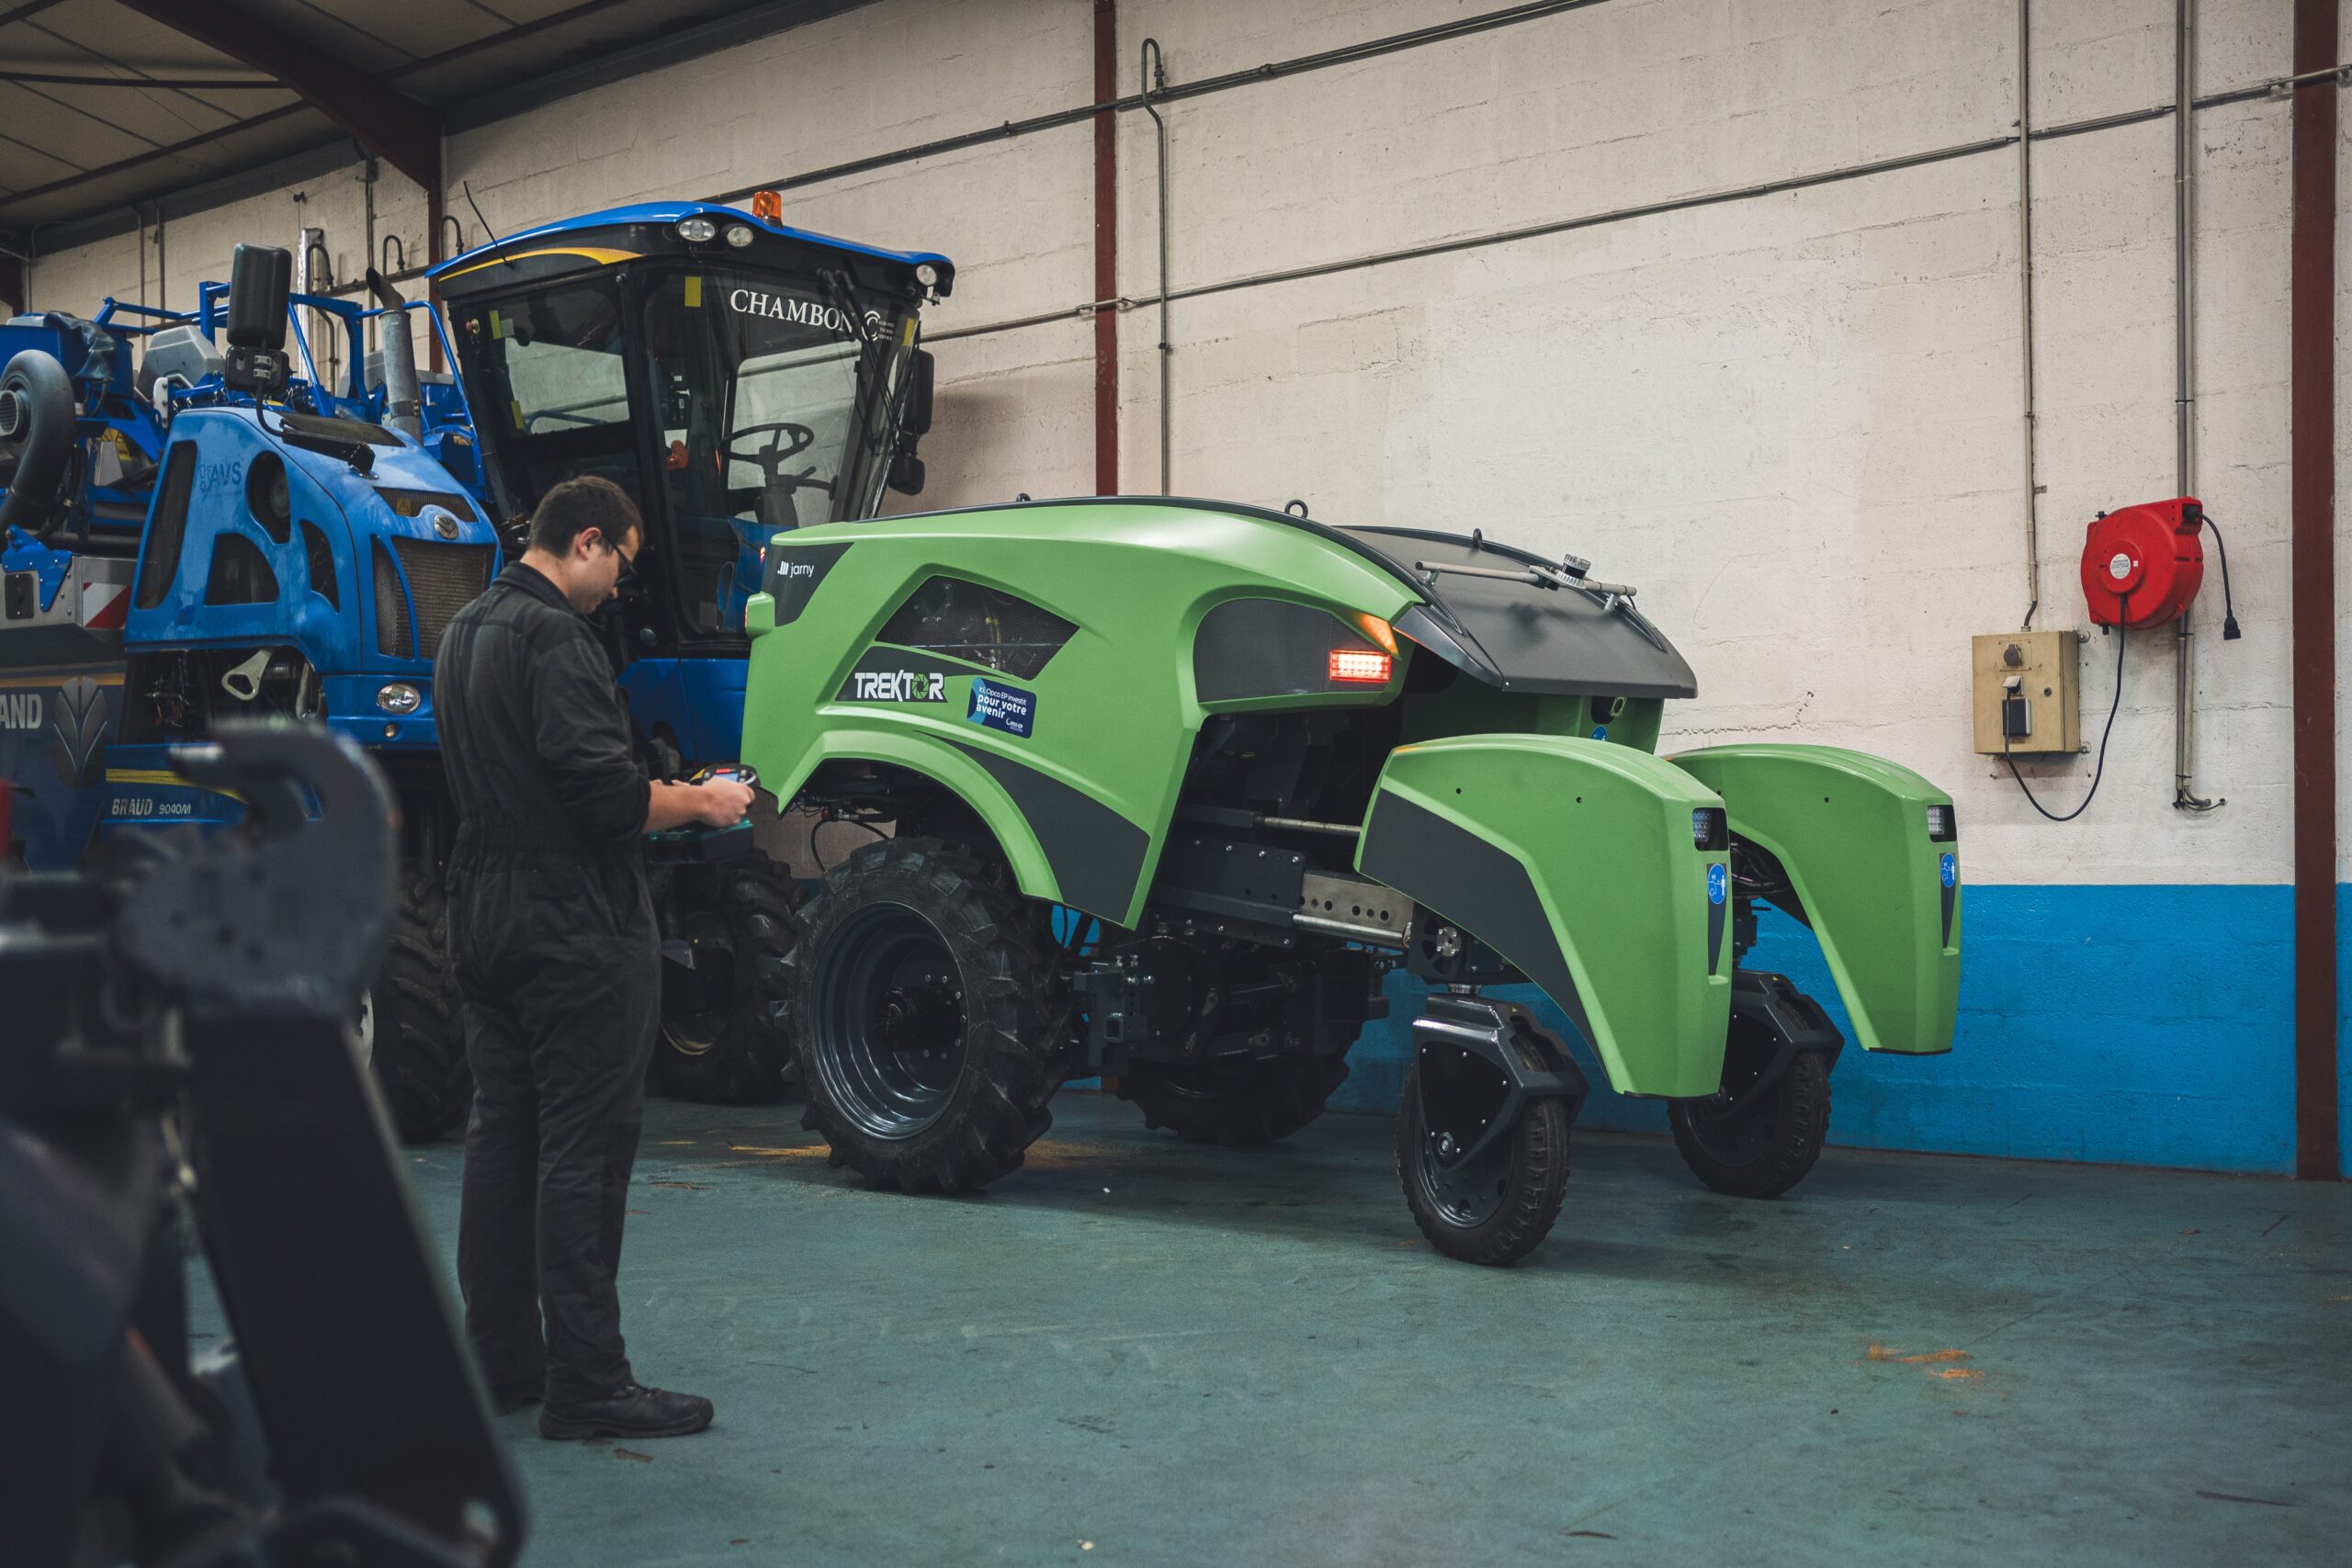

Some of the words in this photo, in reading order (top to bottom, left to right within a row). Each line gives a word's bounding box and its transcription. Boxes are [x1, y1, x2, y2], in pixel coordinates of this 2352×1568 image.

[730, 288, 853, 333] CHAMBON
[790, 562, 815, 578] jarny
[854, 669, 944, 703] TREKTOR
[976, 703, 1006, 719] avenir
[977, 694, 1001, 707] pour
[1001, 700, 1027, 716] votre
[111, 798, 153, 816] BRAUD
[158, 803, 191, 815] 9040M
